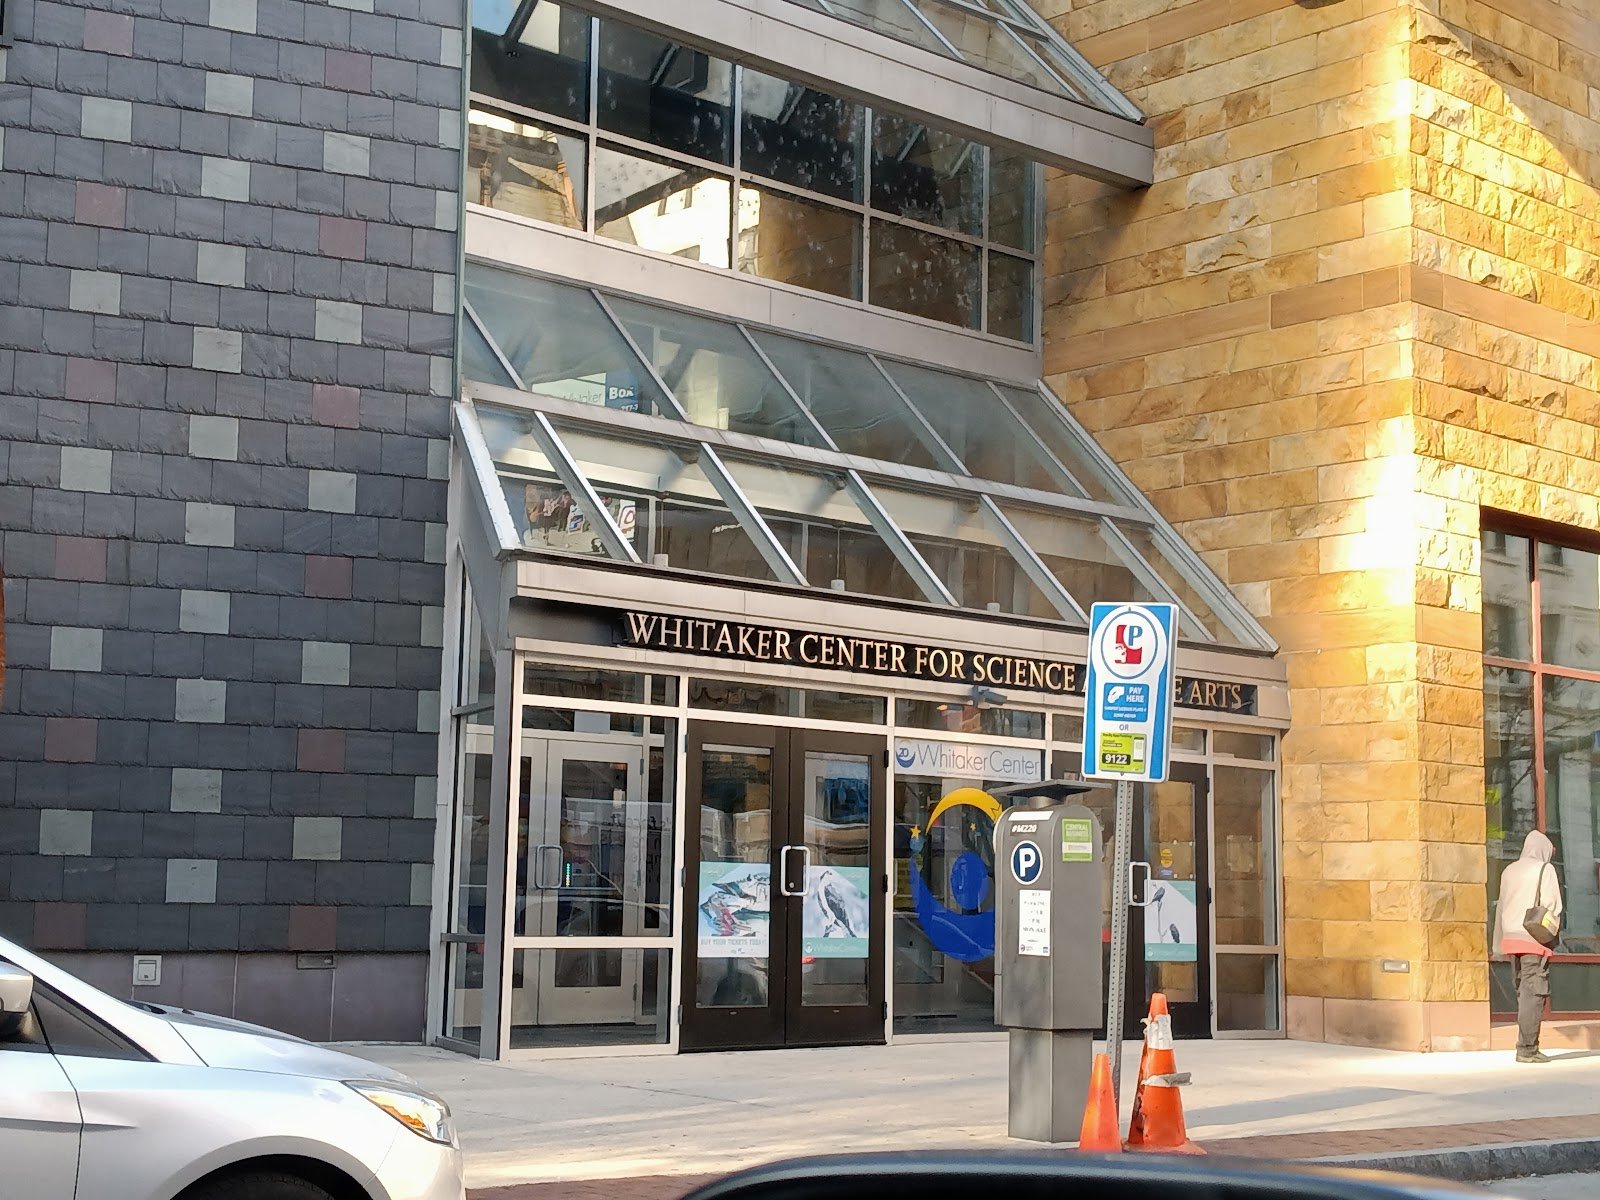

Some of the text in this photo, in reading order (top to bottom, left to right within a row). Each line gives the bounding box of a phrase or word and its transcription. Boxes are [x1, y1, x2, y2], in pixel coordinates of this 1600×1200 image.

[626, 612, 792, 660] WHITAKER
[800, 634, 907, 673] CENTER
[914, 647, 966, 678] FOR
[973, 654, 1077, 691] SCIENCE
[1190, 679, 1243, 709] ARTS
[1129, 686, 1142, 694] PAY
[1126, 694, 1144, 703] HERE
[1105, 753, 1128, 764] 9122
[1019, 848, 1036, 877] P
